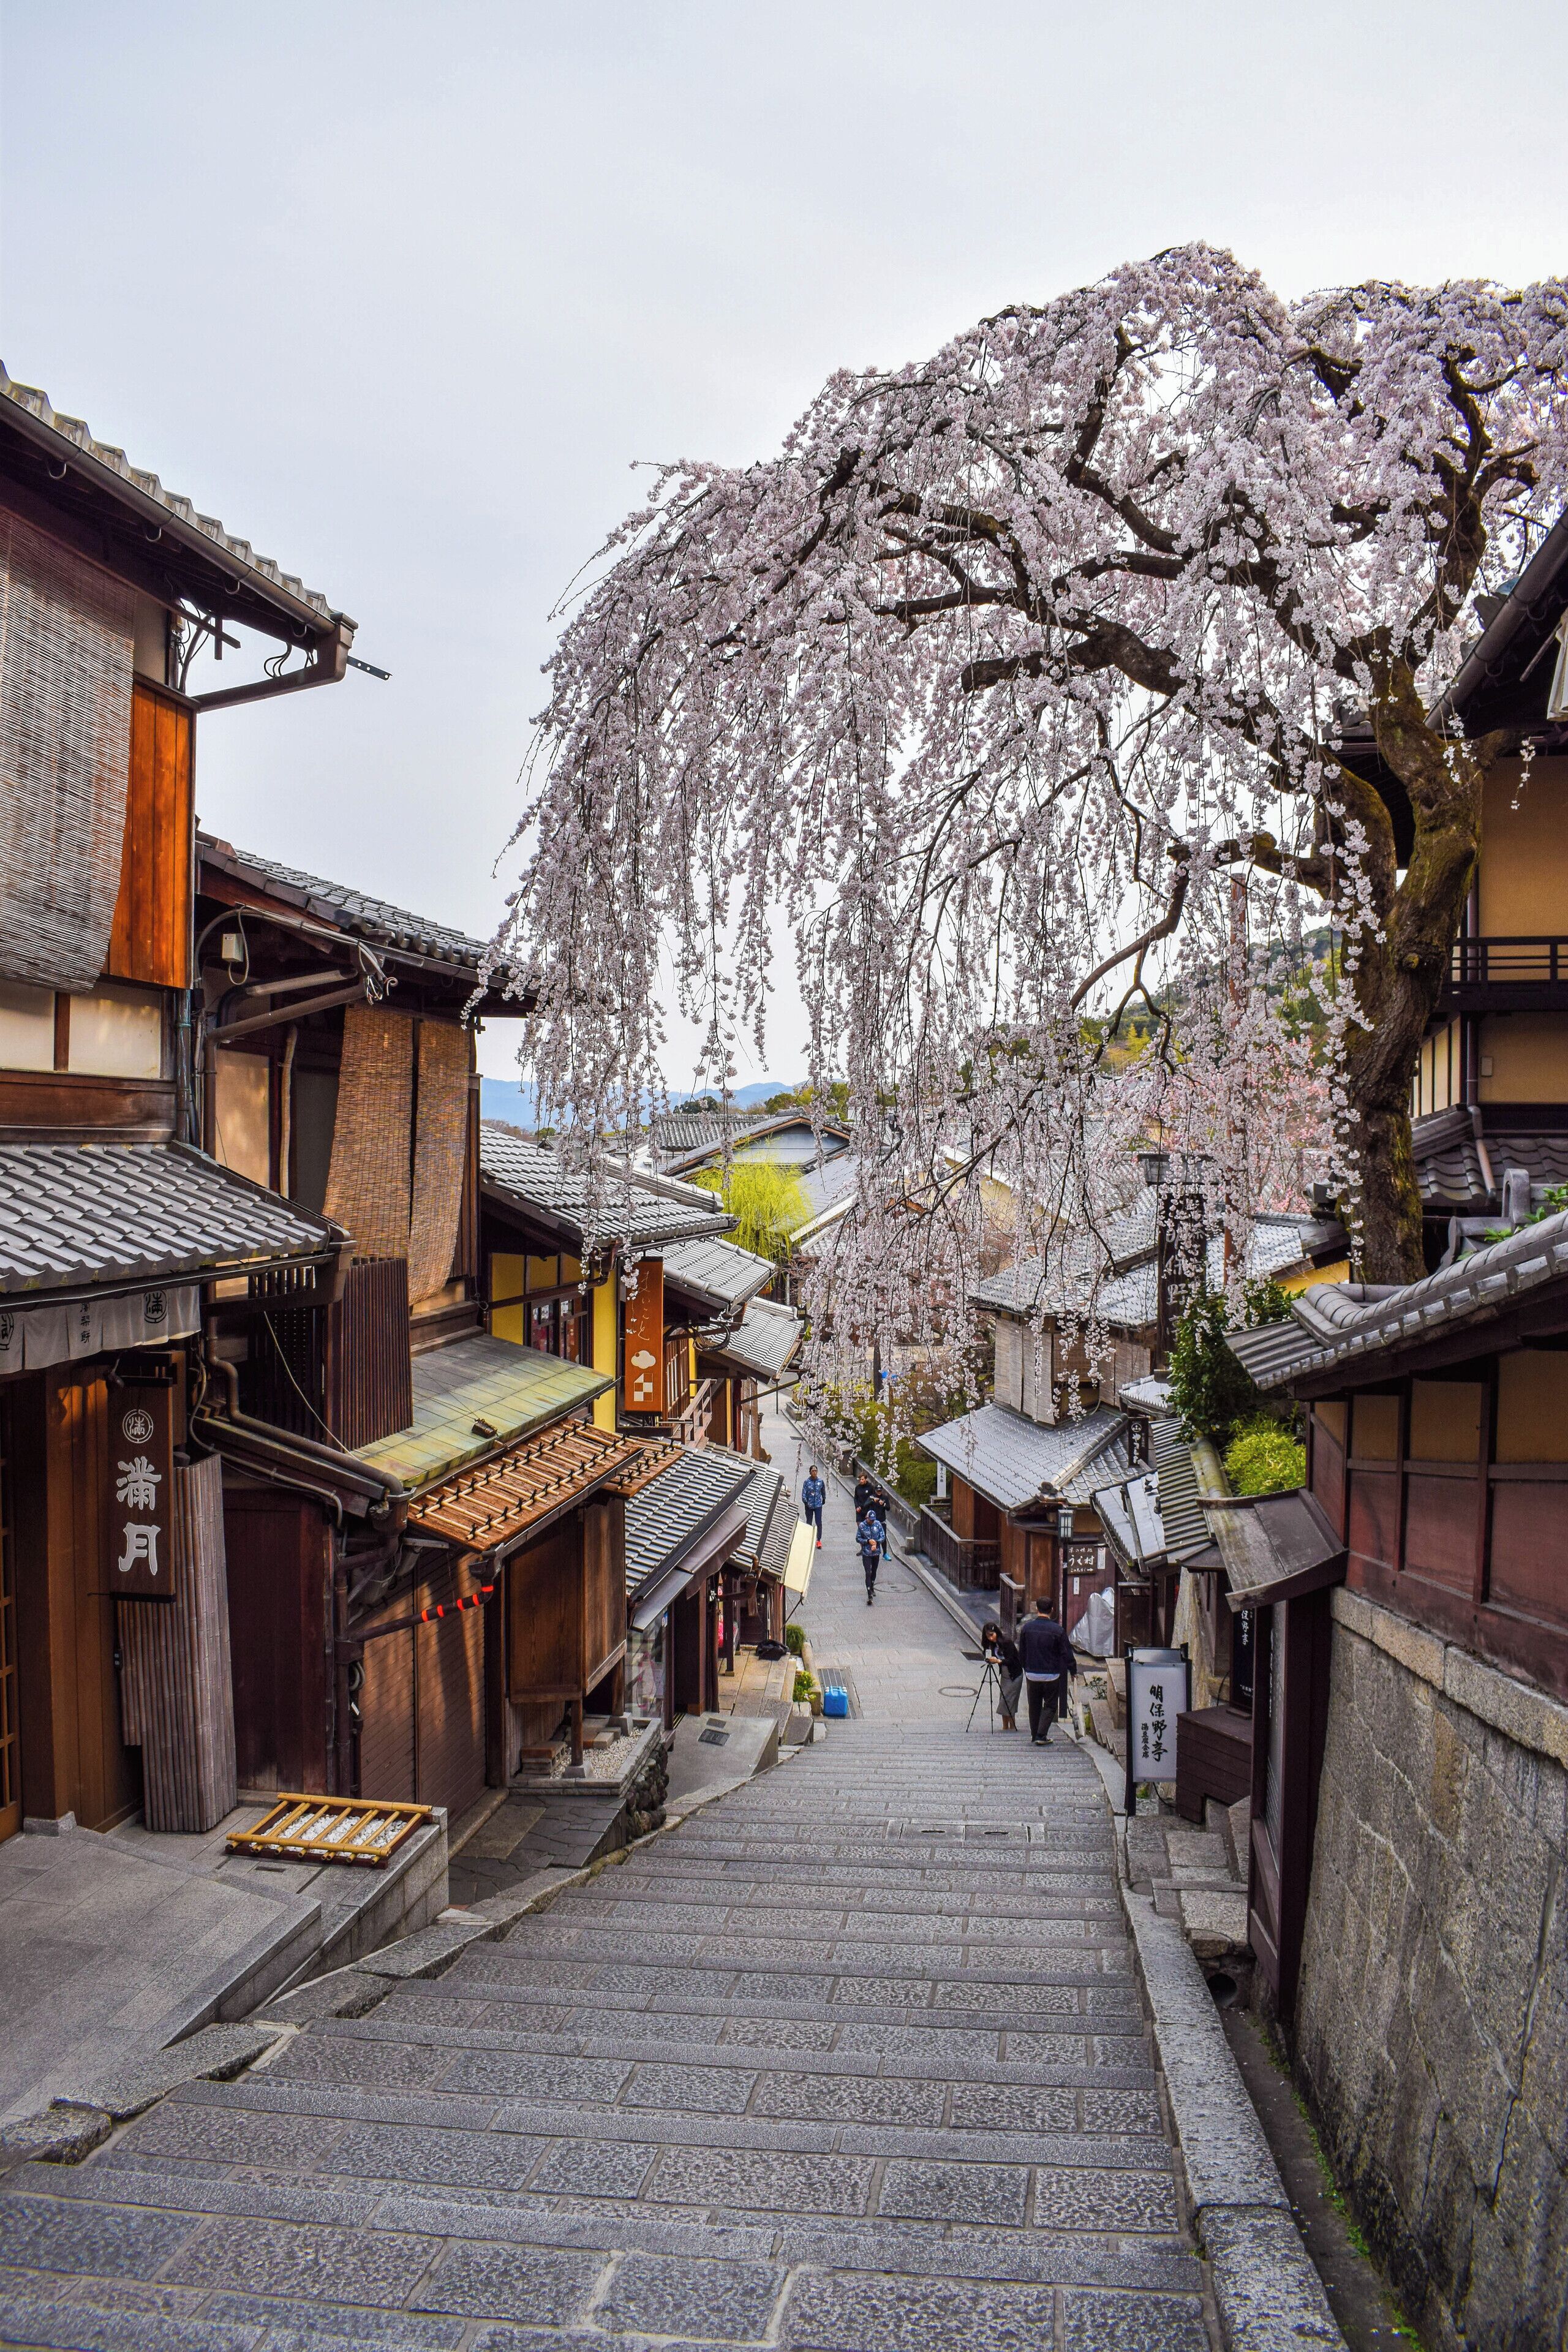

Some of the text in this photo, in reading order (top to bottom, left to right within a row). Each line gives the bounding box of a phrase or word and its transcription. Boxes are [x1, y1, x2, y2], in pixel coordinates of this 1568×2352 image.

[1141, 1722, 1150, 1759] 湯豆腐会席
[1149, 1684, 1168, 1762] 明保野亭
